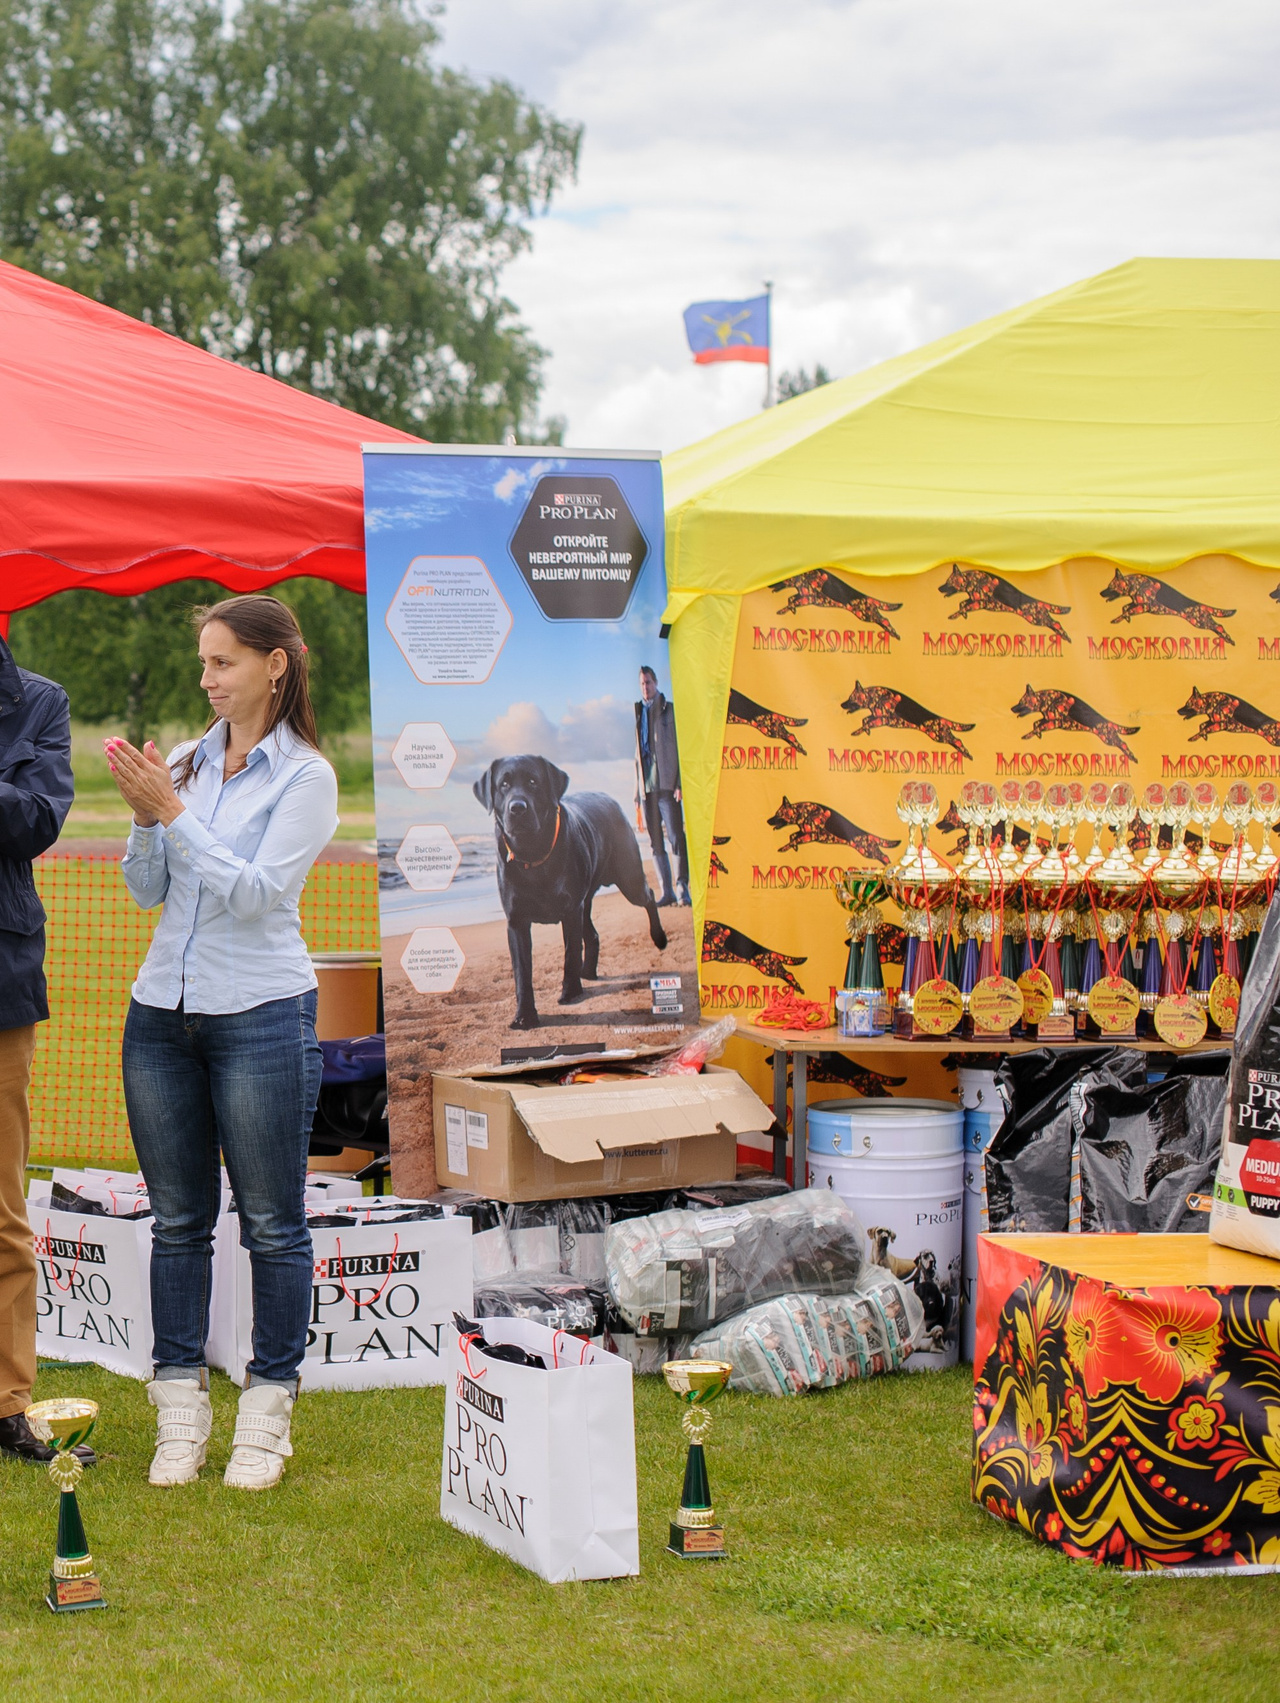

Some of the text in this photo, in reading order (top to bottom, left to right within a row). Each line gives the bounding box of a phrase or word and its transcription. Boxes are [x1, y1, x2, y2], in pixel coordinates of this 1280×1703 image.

[565, 495, 599, 504] PURINA
[540, 505, 616, 519] PRO PLAN
[553, 534, 608, 547] ОТКРОЙТЕ
[529, 551, 632, 564] НЕВЕРОЯТНЫЙ МИР
[532, 568, 631, 582] ВАШЕМУ ПИТОМЦУ
[753, 626, 891, 654] МОСКОВИЯ
[923, 631, 1064, 658] МОСКОВИЯ
[1087, 636, 1227, 660] МОСКОВИЯ
[404, 753, 444, 761] доказанная
[411, 744, 437, 752] Научно
[828, 748, 965, 775] МОСКОВИЯ
[995, 753, 1131, 777] МОСКОВИЯ
[407, 864, 452, 872] ингредиенты
[410, 948, 431, 956] Особое
[1258, 1073, 1280, 1083] PUR
[1247, 1083, 1280, 1109] PR
[1238, 1104, 1280, 1131] PLA
[1246, 1158, 1280, 1176] MEDIU
[1251, 1194, 1279, 1211] PUPPY
[915, 1213, 939, 1225] PRO
[49, 1242, 103, 1262] PURINA
[331, 1254, 416, 1276] PURINA
[37, 1259, 112, 1305] PRO
[313, 1283, 419, 1323] PRO
[463, 1381, 503, 1421] PURINA
[456, 1402, 507, 1477] PRO
[447, 1445, 528, 1537] PLAN
